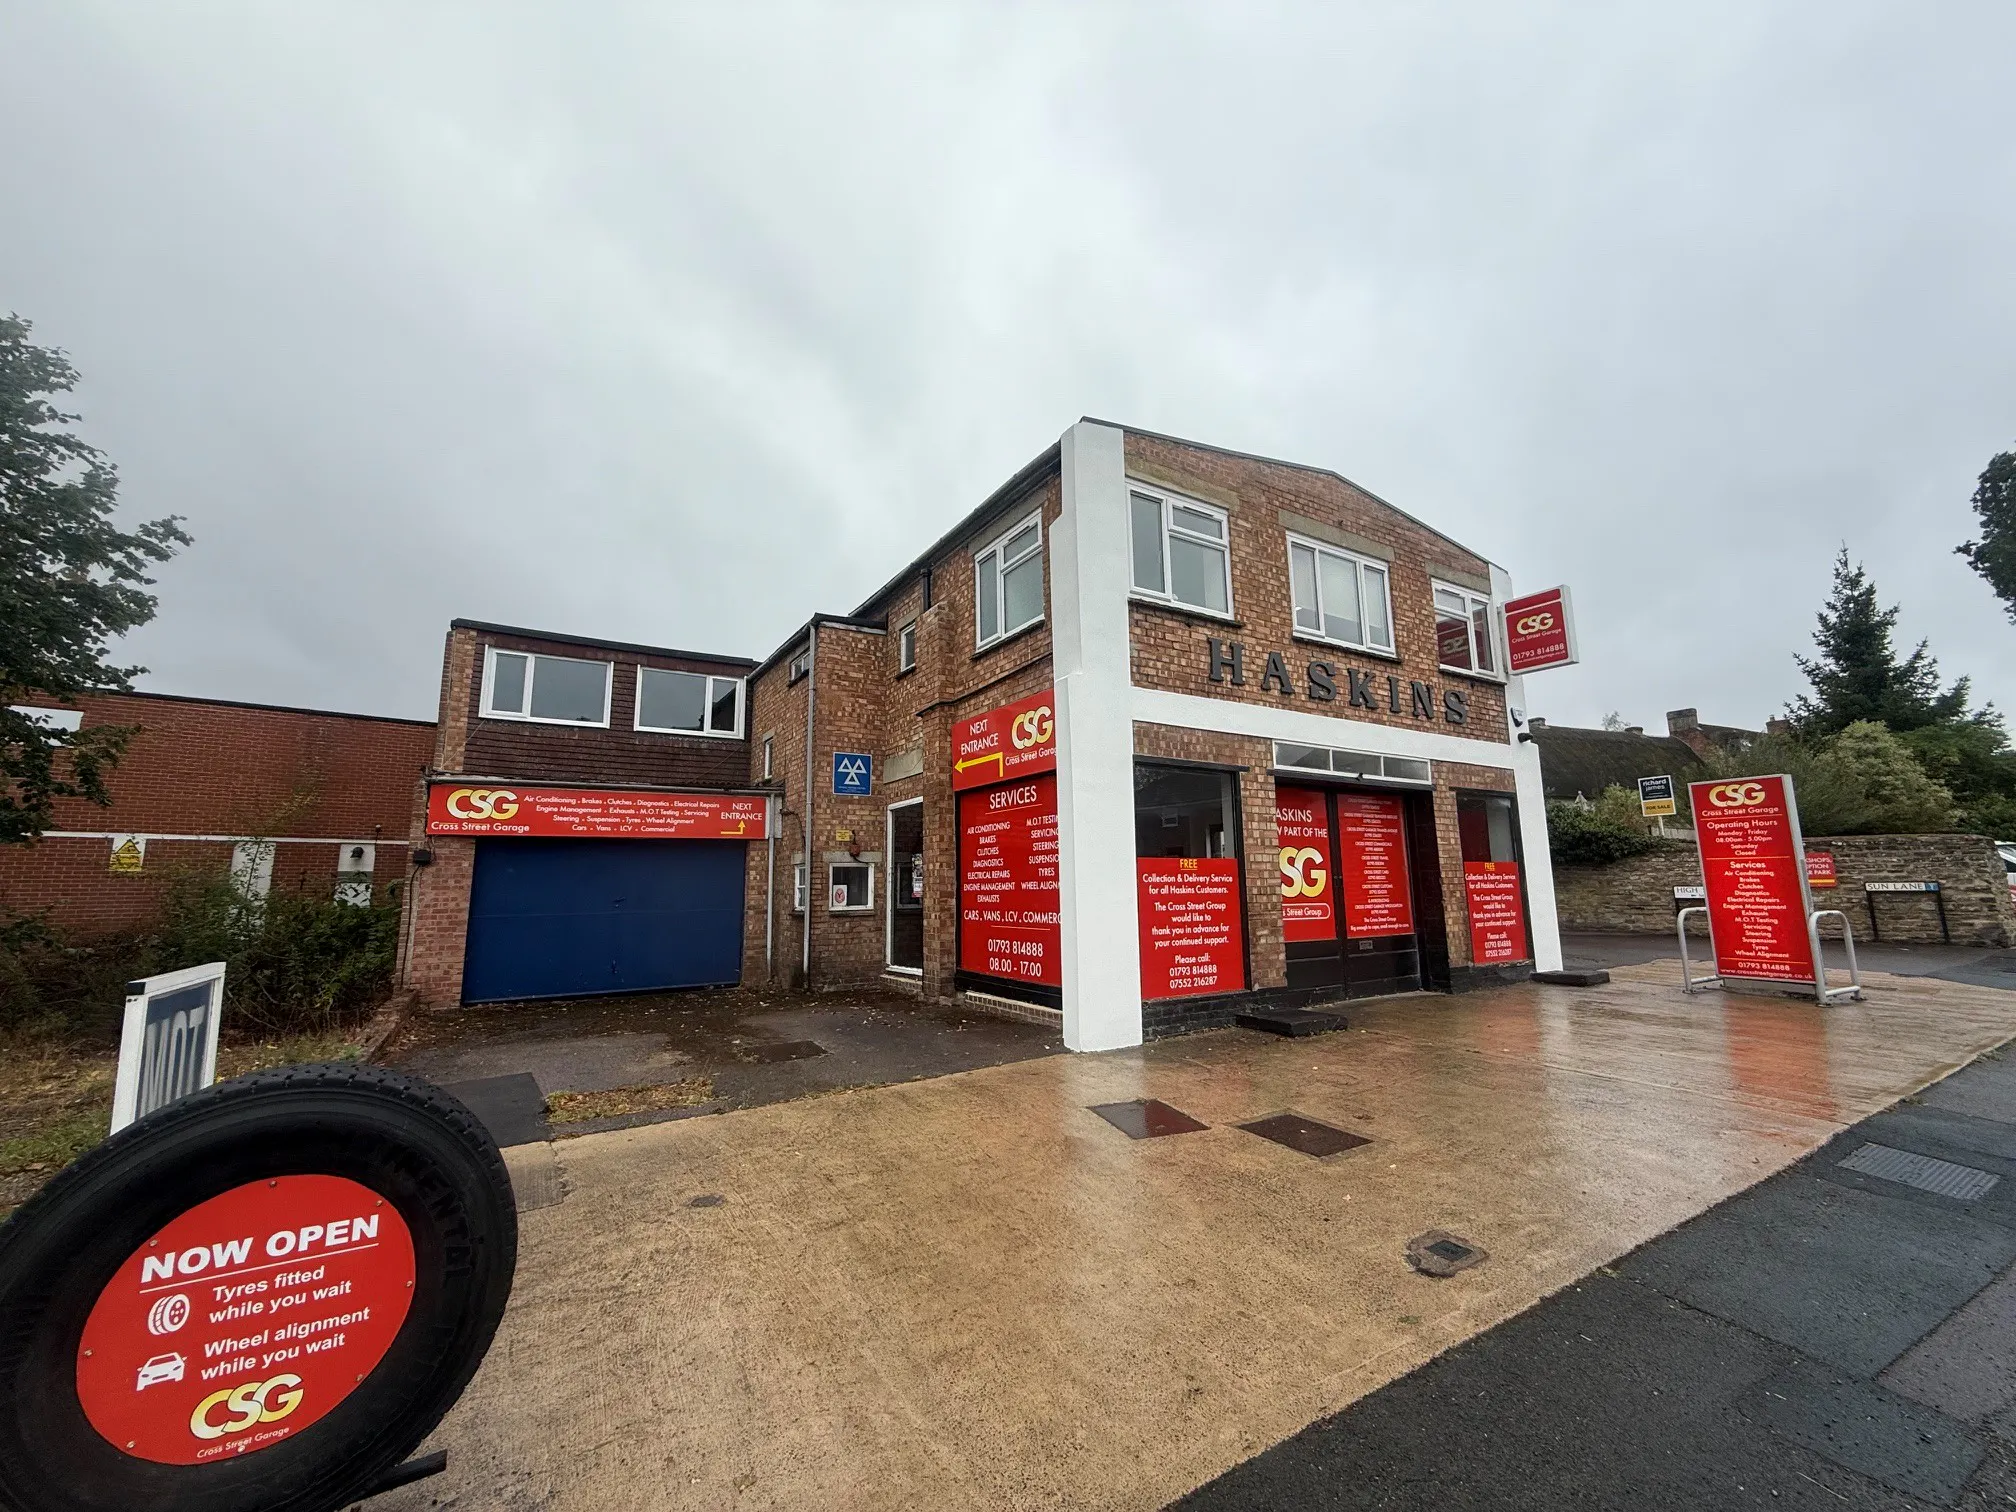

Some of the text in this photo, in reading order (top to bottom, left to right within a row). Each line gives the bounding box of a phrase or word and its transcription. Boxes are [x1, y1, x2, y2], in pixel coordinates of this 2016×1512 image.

[1517, 613, 1553, 634] CSG
[1513, 650, 1534, 660] 01793
[1537, 643, 1564, 655] 814888
[1208, 638, 1468, 724] HASKINS
[970, 719, 988, 736] NEXT
[1012, 706, 1053, 749] CSG
[961, 733, 998, 755] ENTRANCE
[1005, 751, 1037, 766] Cross Street
[536, 796, 576, 805] Conditioning
[990, 785, 1036, 809] SERVICES
[1709, 783, 1765, 807] CSG
[447, 789, 519, 820] CSG
[536, 805, 558, 813] Engine
[560, 806, 601, 814] Management
[553, 815, 580, 823] Steering
[721, 812, 762, 820] ENTRANCE
[1276, 808, 1312, 822] ASKINS
[431, 822, 530, 833] Cross Street Garage
[975, 822, 1010, 833] CONDITIONING
[1284, 826, 1301, 836] PART
[1303, 828, 1313, 837] OF
[1314, 828, 1327, 837] THE
[1707, 821, 1749, 830] Operating
[979, 835, 996, 844] BRAKES
[977, 847, 999, 856] CLUTCHES
[973, 858, 1004, 868] DIAGNOSTICS
[1180, 859, 1198, 868] FREE
[968, 870, 1010, 879] ELECTRICAL REPAIRS
[1038, 868, 1054, 876] TYRES
[1280, 846, 1326, 898] SG
[1143, 873, 1232, 884] Collection & Delivery Service
[964, 882, 1015, 891] ENGINE MANAGEMENT
[1021, 881, 1039, 890] WHEEL
[1149, 885, 1158, 894] for
[1170, 885, 1194, 894] Haskins
[1196, 885, 1228, 894] Customers.
[977, 894, 999, 902] EXHAUSTS
[1154, 901, 1226, 912] The Cross Street Group
[1287, 908, 1303, 916] Street
[1304, 907, 1322, 918] Group
[964, 910, 979, 920] CARS
[983, 911, 1000, 921] VANS
[1005, 911, 1018, 922] LCV
[1172, 913, 1191, 922] would
[1193, 913, 1203, 921] like
[1152, 923, 1229, 936] thank you in advance for
[988, 939, 1043, 957] 01793 814888
[1155, 936, 1229, 950] your continued support.
[1175, 955, 1196, 964] Please
[989, 958, 1041, 977] 08.00 17.00
[1170, 965, 1217, 976] 01793 814888
[1170, 976, 1217, 988] 07552 216287
[140, 1005, 206, 1118] MOT
[141, 1214, 379, 1283] NOW OPEN
[213, 1265, 325, 1303] Tyres fitted
[209, 1280, 352, 1324] while you wait
[204, 1307, 370, 1358] Wheel alignment
[201, 1333, 345, 1380] while you wait
[190, 1373, 304, 1440] CSG
[196, 1427, 289, 1458] Cross Street Garage
